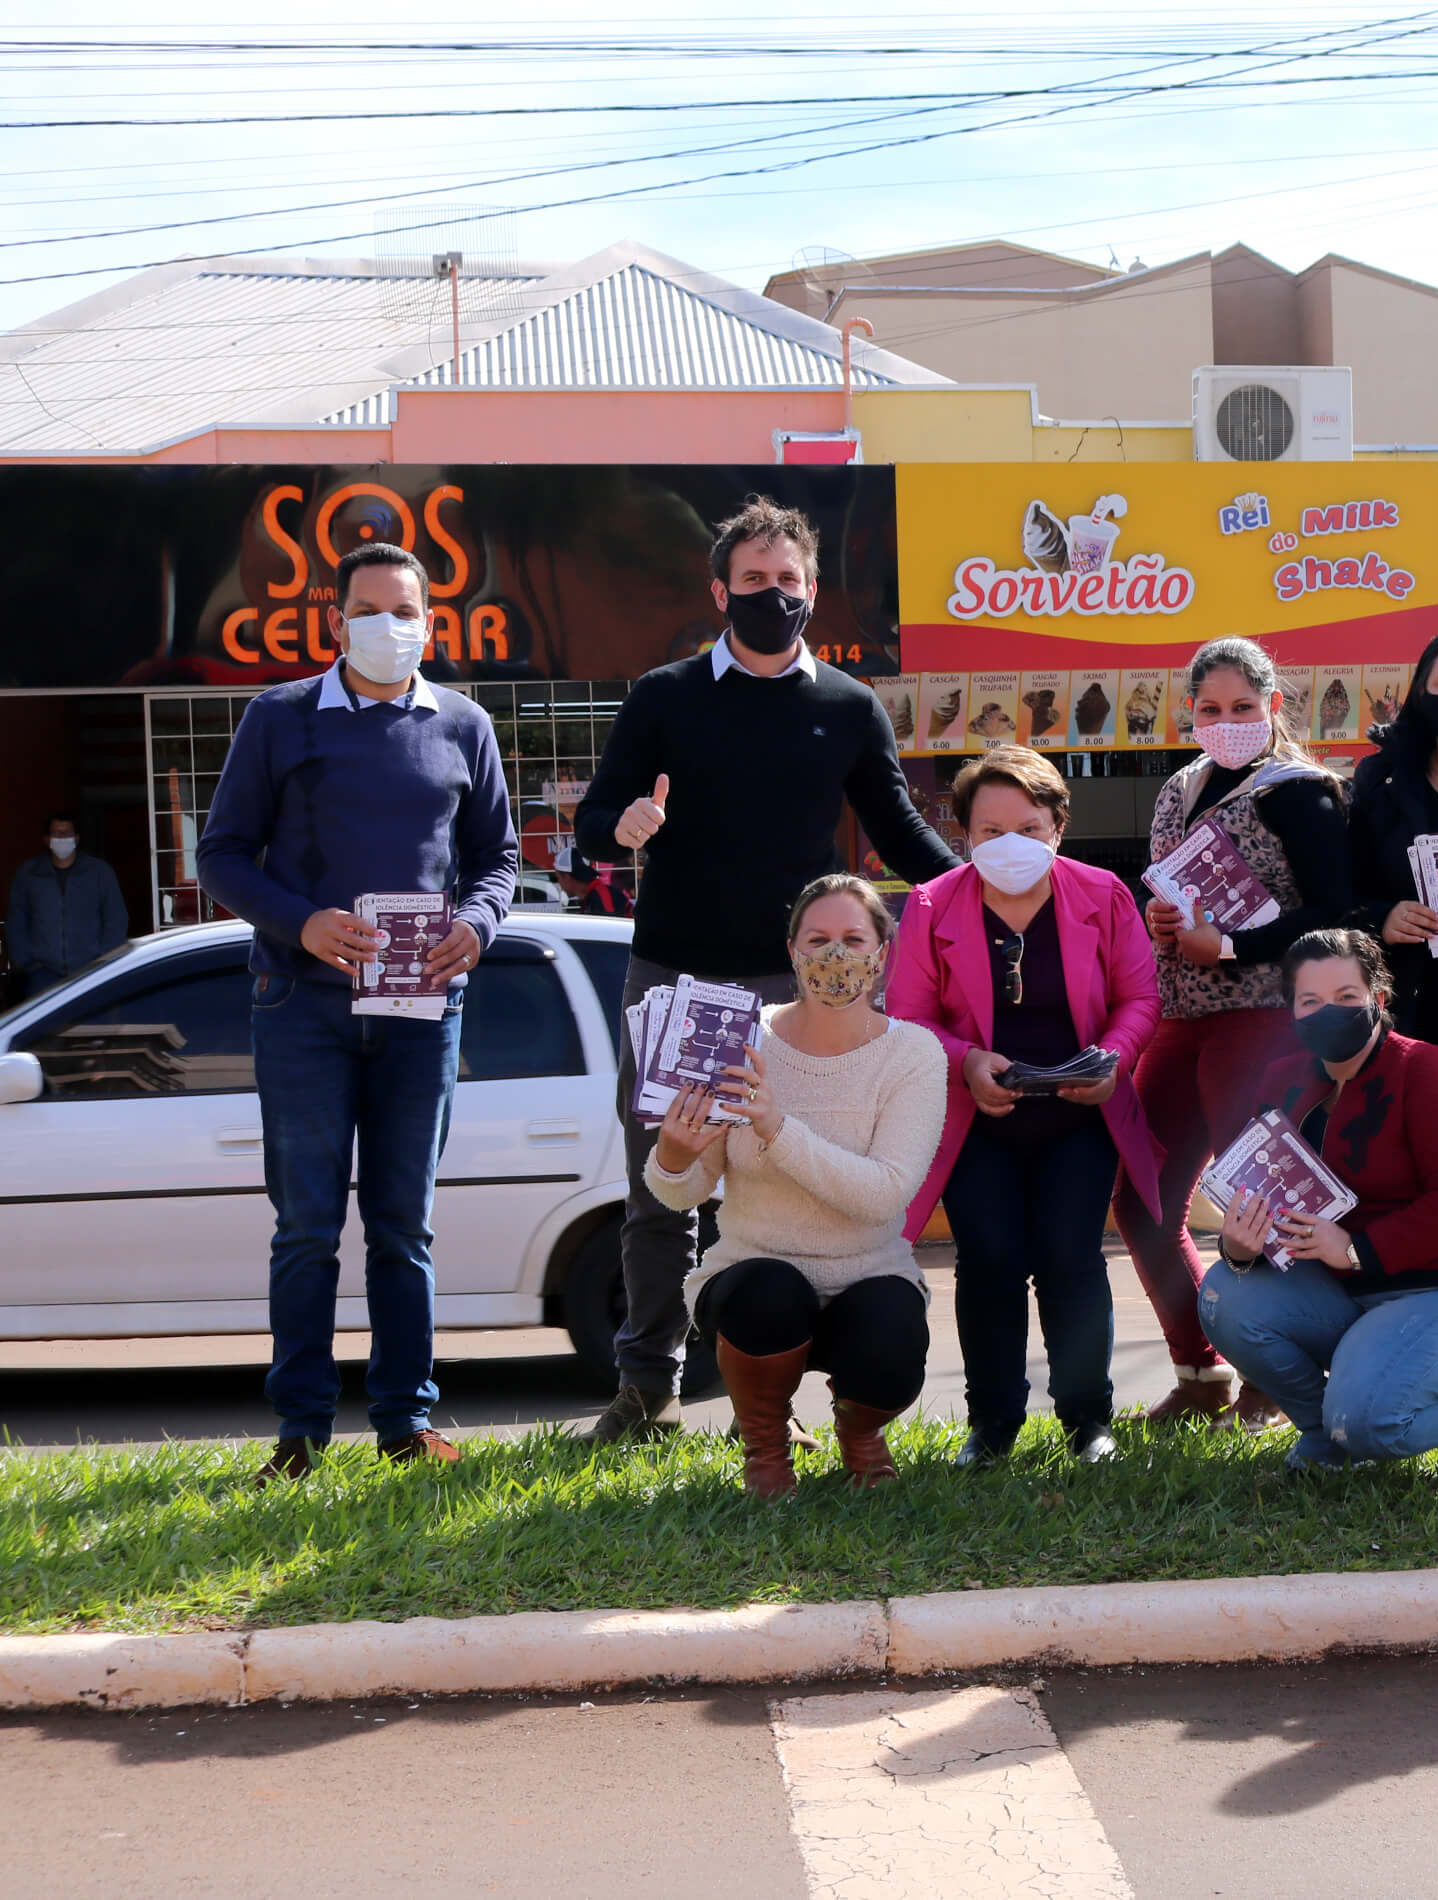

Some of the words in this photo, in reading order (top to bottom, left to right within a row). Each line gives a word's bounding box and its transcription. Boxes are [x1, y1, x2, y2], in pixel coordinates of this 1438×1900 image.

[1222, 499, 1269, 533] Rei
[1303, 502, 1398, 533] Milk
[263, 483, 469, 599] SOS
[1271, 532, 1297, 554] do
[954, 558, 1190, 614] Sorvetão
[1276, 554, 1414, 599] Shake
[221, 604, 509, 664] CELAR
[973, 674, 1017, 684] CASQUINHA
[933, 741, 950, 749] 6.00
[1085, 737, 1104, 745] 8.00
[1136, 736, 1155, 744] 8.00
[1330, 731, 1347, 739] 9.00
